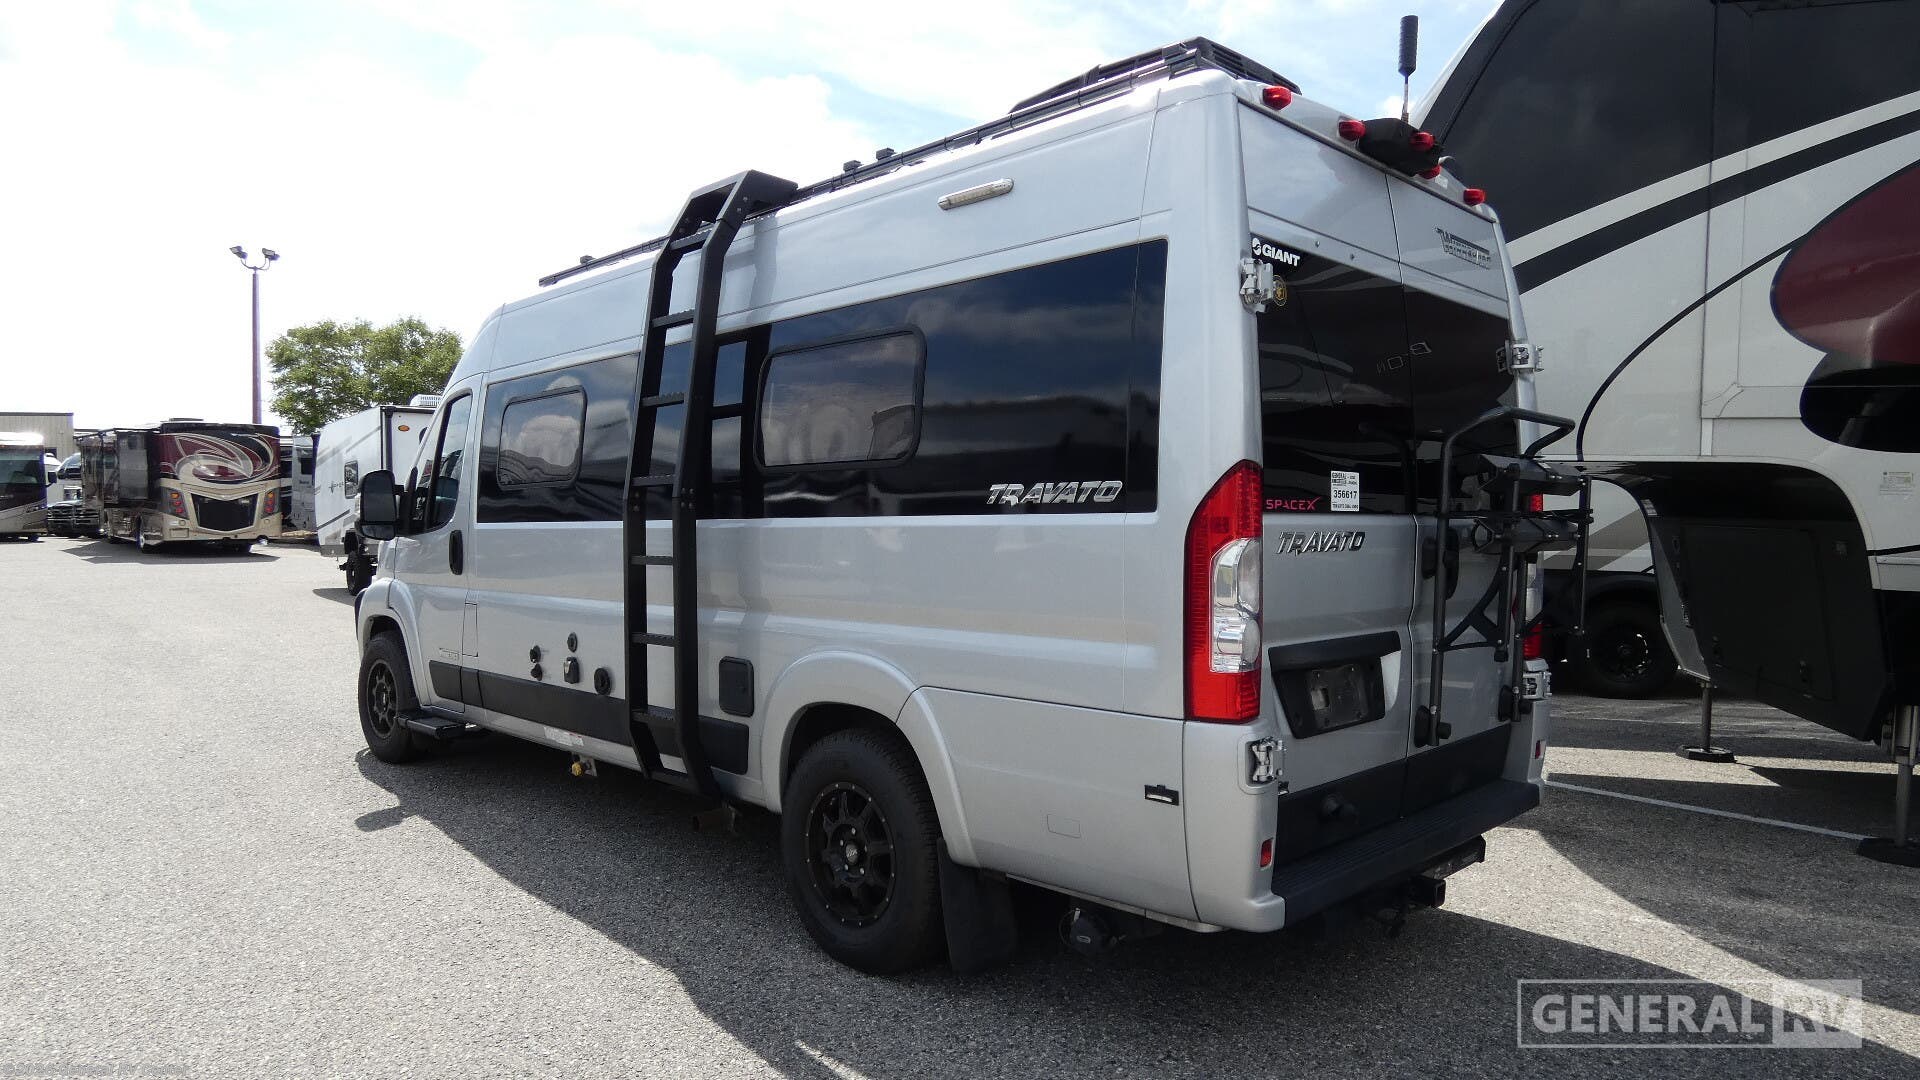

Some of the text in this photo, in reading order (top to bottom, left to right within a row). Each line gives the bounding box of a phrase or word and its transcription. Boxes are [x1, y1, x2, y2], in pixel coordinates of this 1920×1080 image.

[1262, 243, 1301, 267] GIANT
[986, 480, 1123, 507] TRAVATO
[1265, 497, 1321, 511] SPACEX
[1333, 490, 1357, 499] 356617
[1277, 531, 1366, 556] TRAVATO
